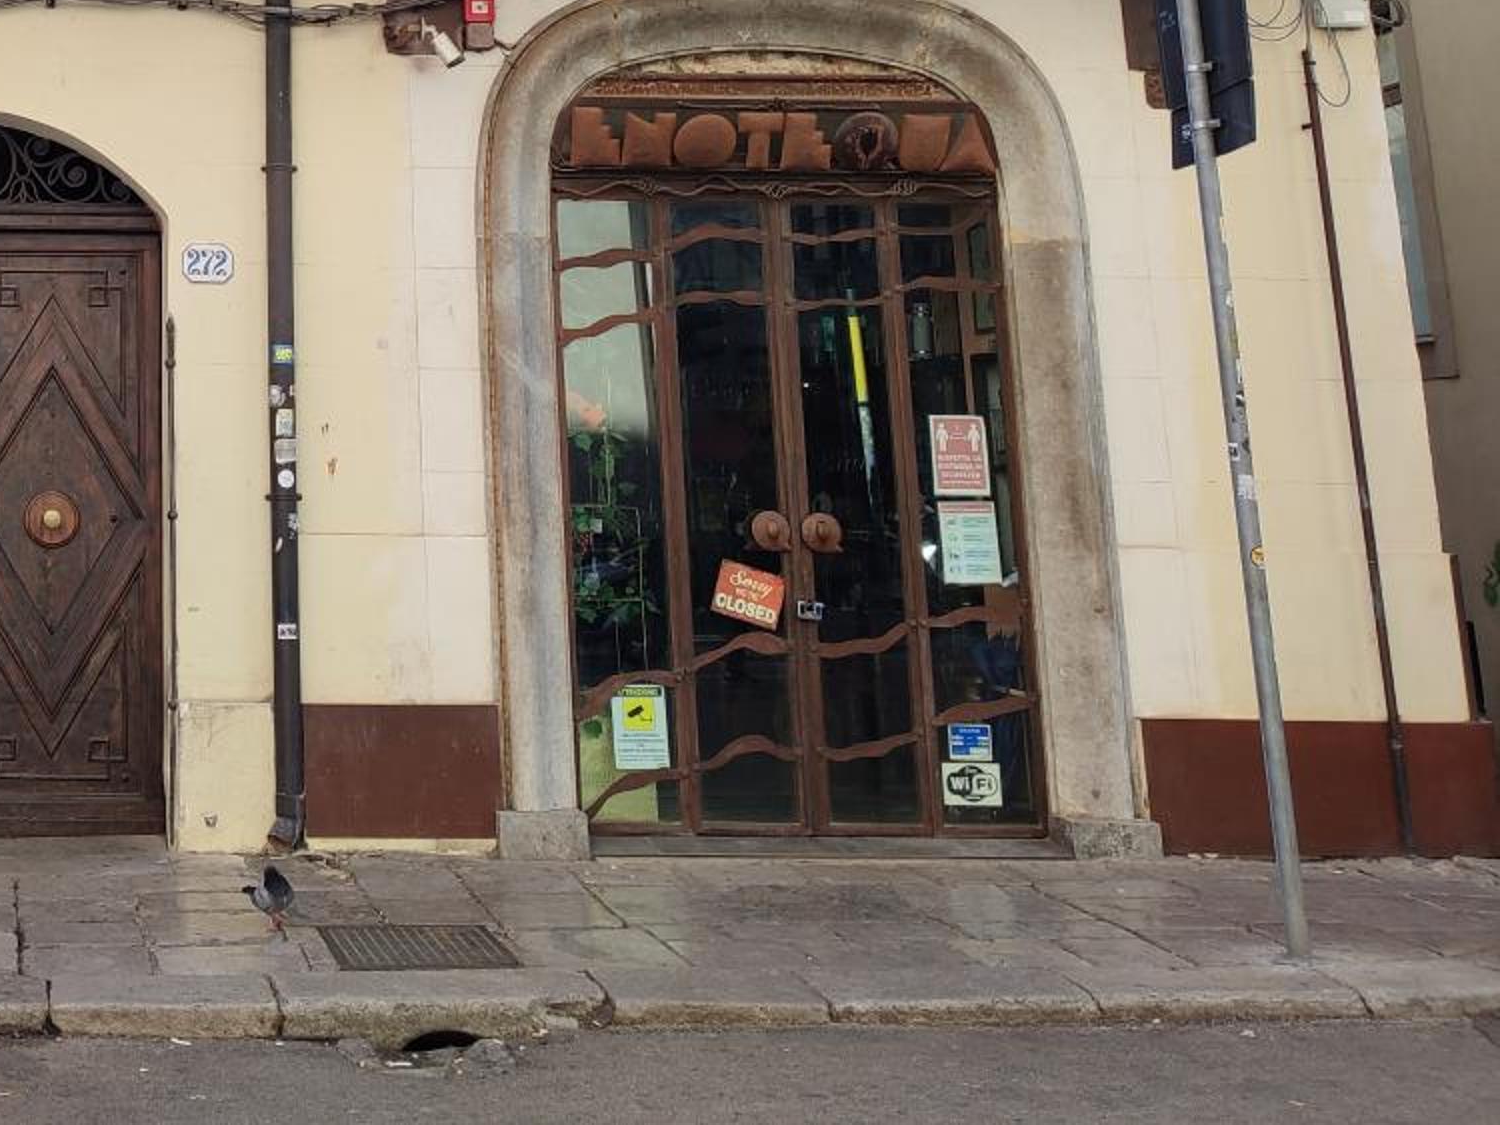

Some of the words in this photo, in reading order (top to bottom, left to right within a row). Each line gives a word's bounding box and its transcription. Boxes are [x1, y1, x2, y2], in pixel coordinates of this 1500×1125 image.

[186, 248, 228, 277] 272
[729, 571, 773, 599] Sorry
[715, 593, 777, 624] CLOSED
